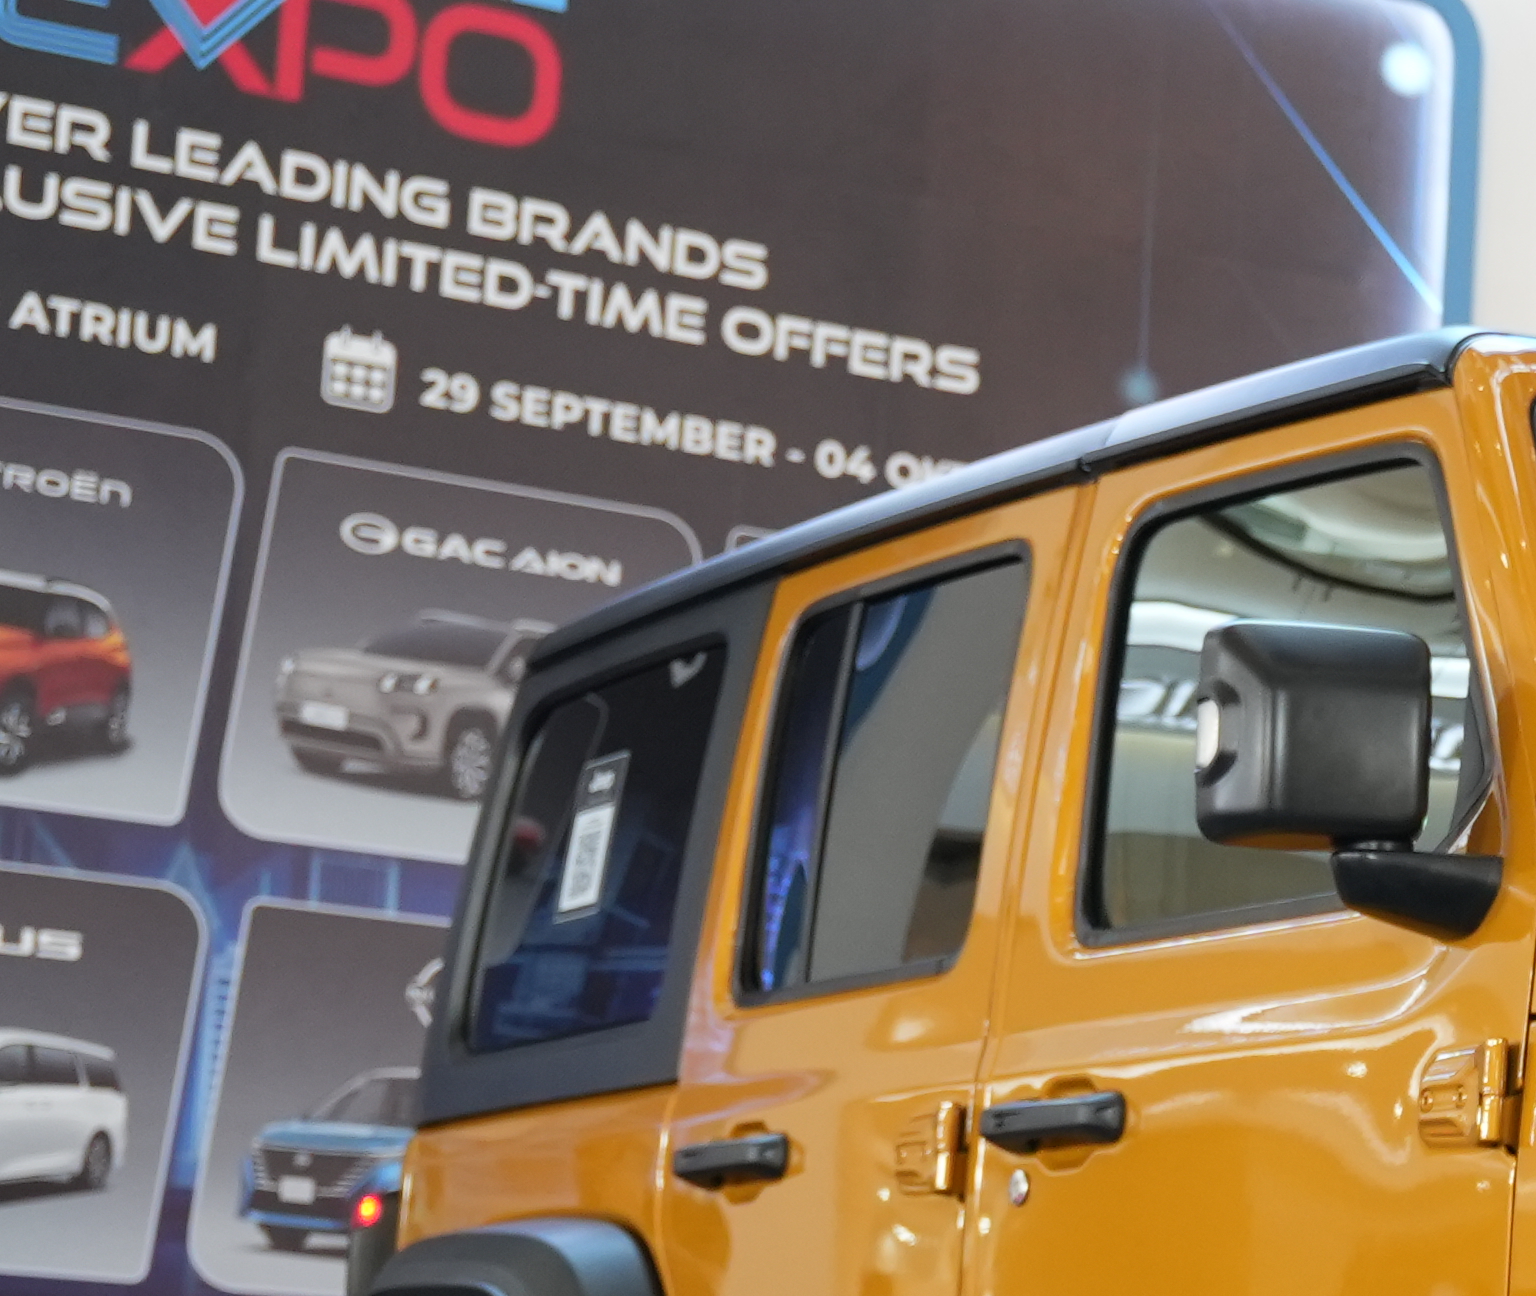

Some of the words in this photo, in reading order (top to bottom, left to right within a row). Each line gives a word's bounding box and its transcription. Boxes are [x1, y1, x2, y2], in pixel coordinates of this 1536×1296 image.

[0, 92, 112, 163] ER
[130, 118, 450, 229] LEADING
[467, 186, 770, 291] BRANDS
[0, 165, 240, 257] USIVE
[256, 213, 709, 346] LIMITED-TIME
[720, 306, 982, 395] OFFERS
[9, 290, 218, 365] ATRIUM
[419, 366, 480, 414] 29
[488, 380, 777, 468] SEPTEMBER
[813, 438, 877, 485] 04
[401, 525, 508, 570] GAC
[509, 546, 623, 588] AION
